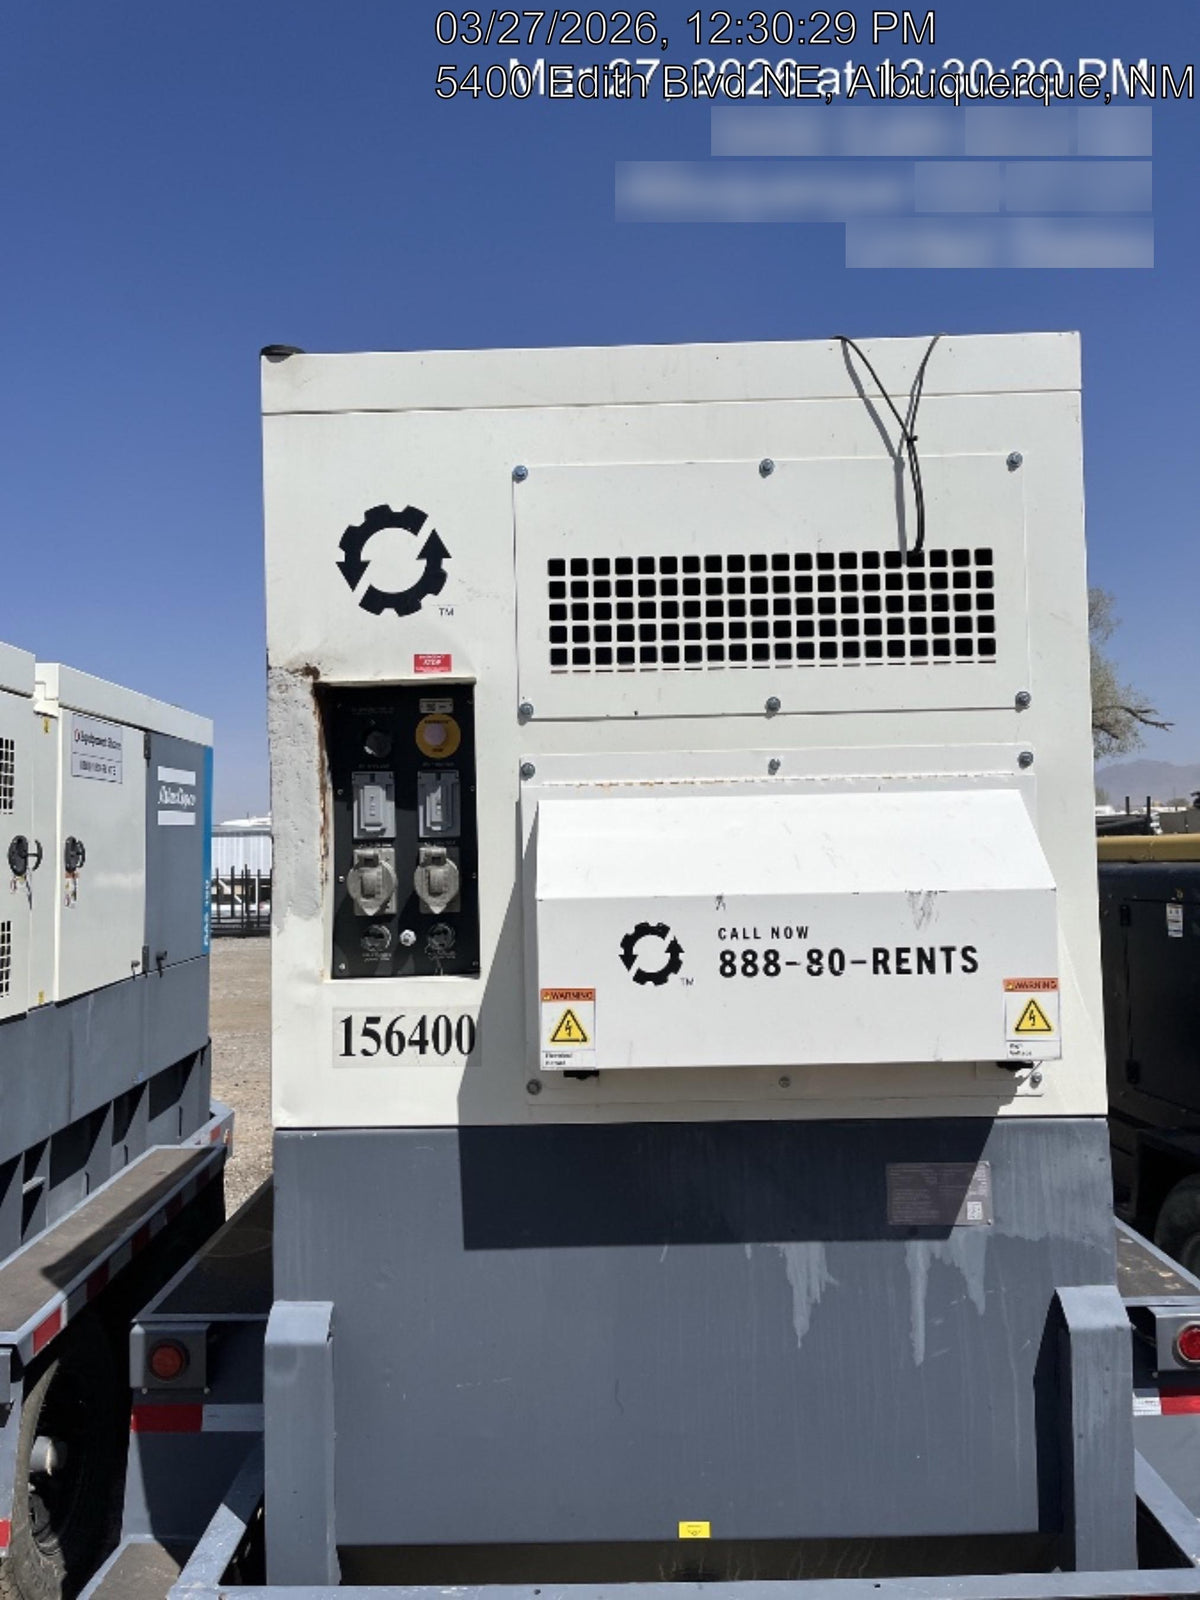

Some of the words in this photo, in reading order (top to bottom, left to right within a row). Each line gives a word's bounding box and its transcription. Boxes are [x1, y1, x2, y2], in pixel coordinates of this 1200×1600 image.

[718, 927, 761, 940] CALL
[771, 926, 808, 939] NOW
[719, 945, 978, 978] 888-80-RENTS
[1015, 980, 1057, 989] WARNING
[551, 991, 592, 1000] WARNING
[339, 1014, 476, 1057] 156400
